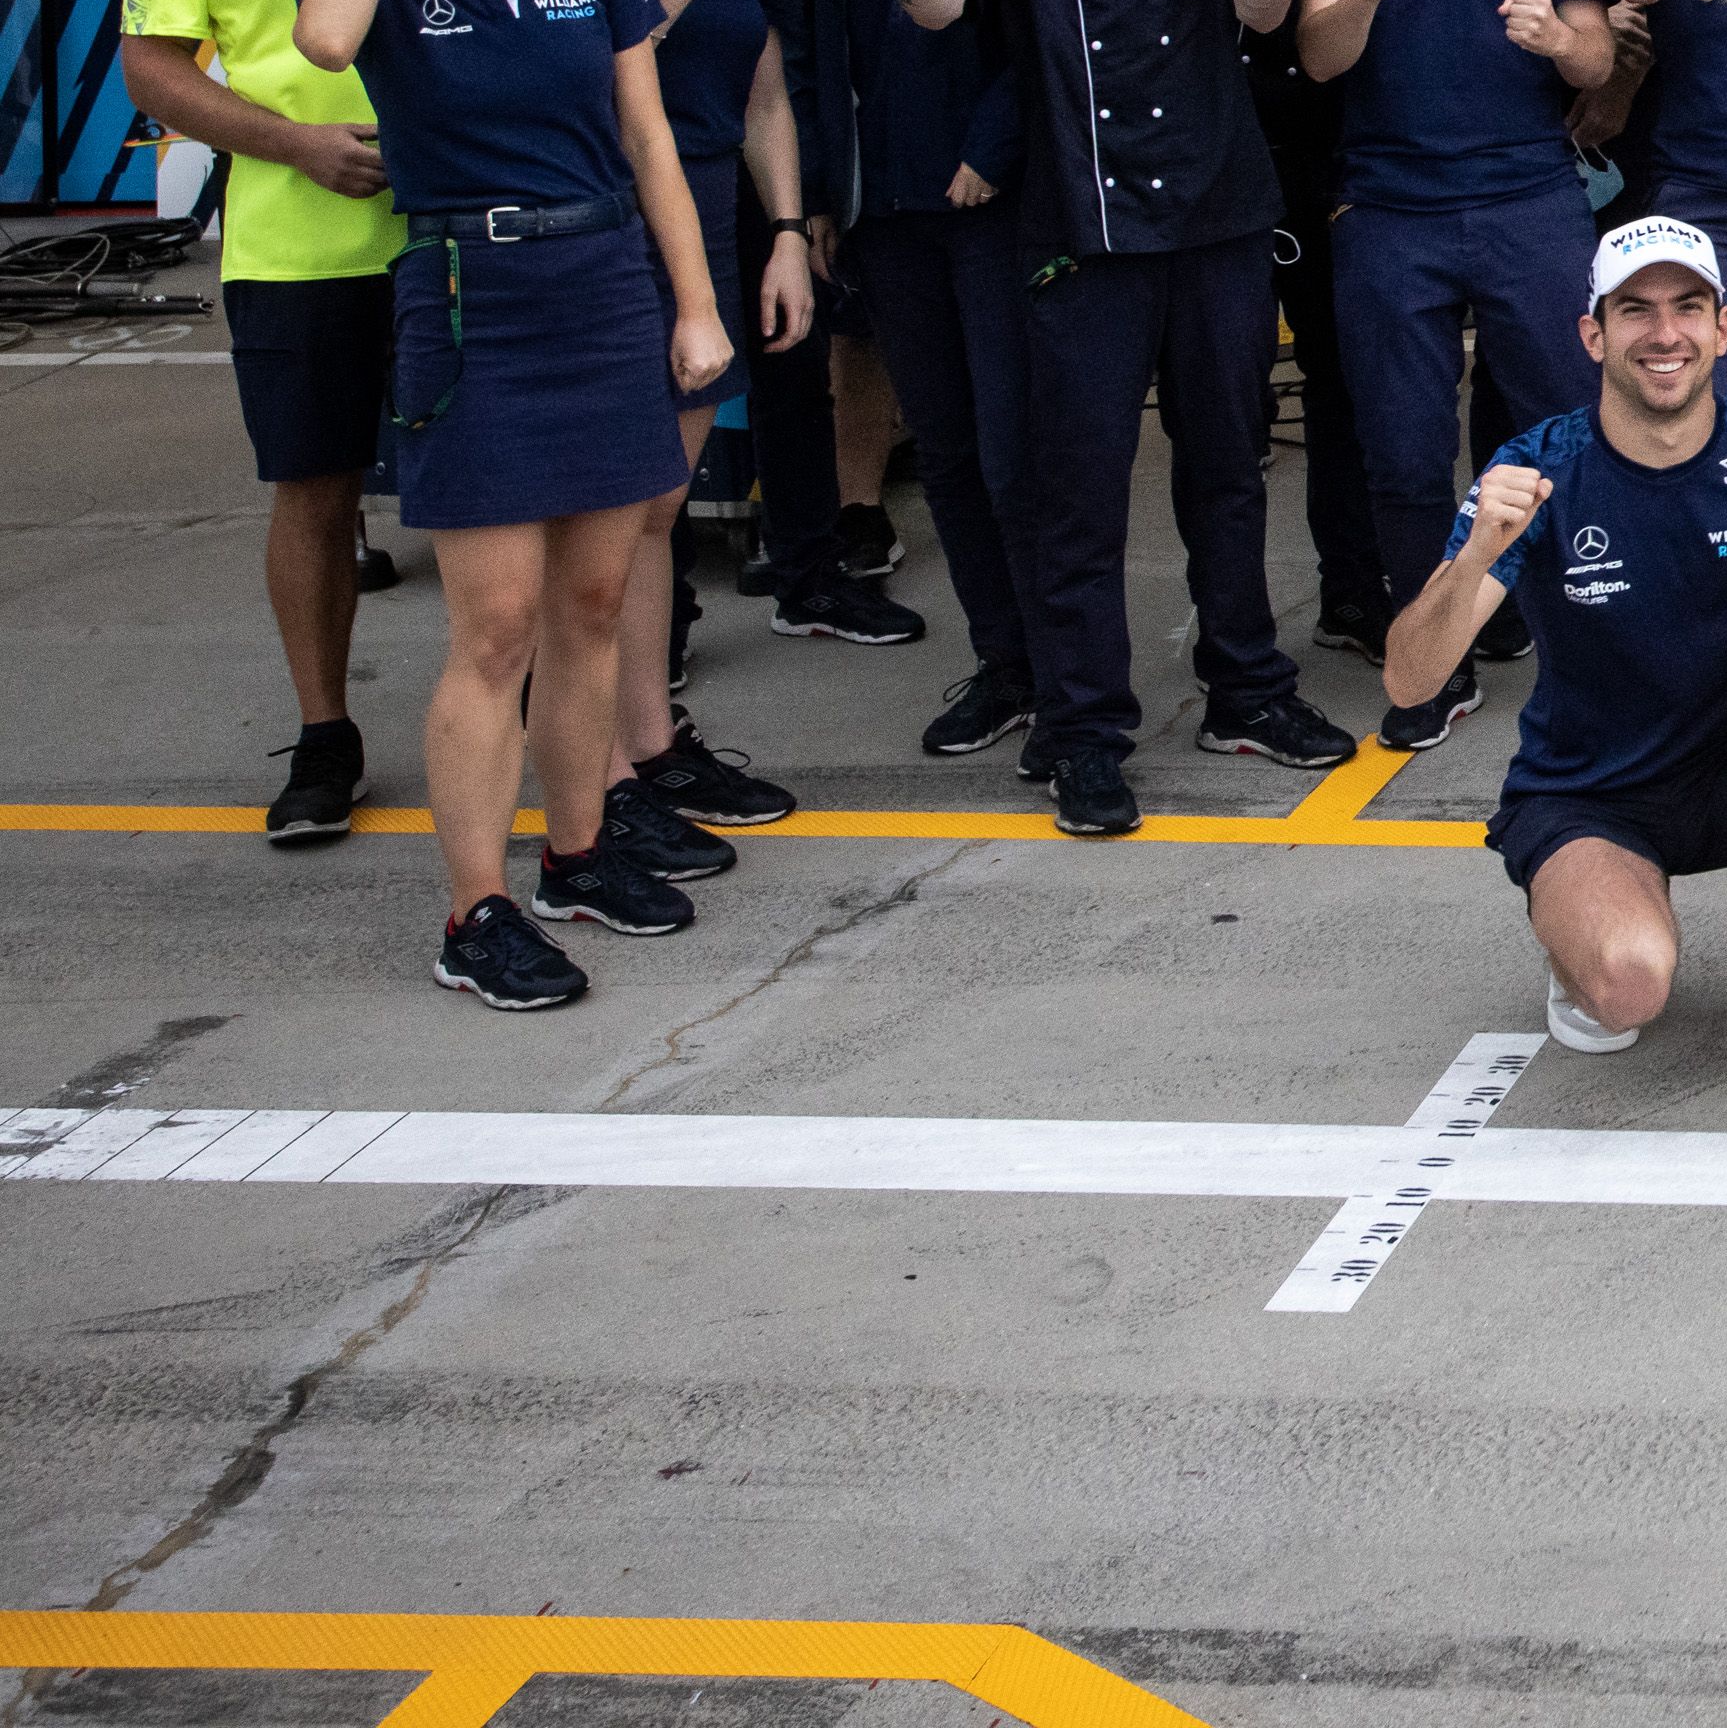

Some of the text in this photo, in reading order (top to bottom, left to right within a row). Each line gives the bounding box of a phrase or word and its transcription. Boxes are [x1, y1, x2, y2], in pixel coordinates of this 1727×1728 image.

[546, 6, 596, 21] RACING
[1610, 223, 1702, 249] WILLIAMS
[1622, 234, 1694, 257] RACING
[1565, 560, 1624, 575] AMG
